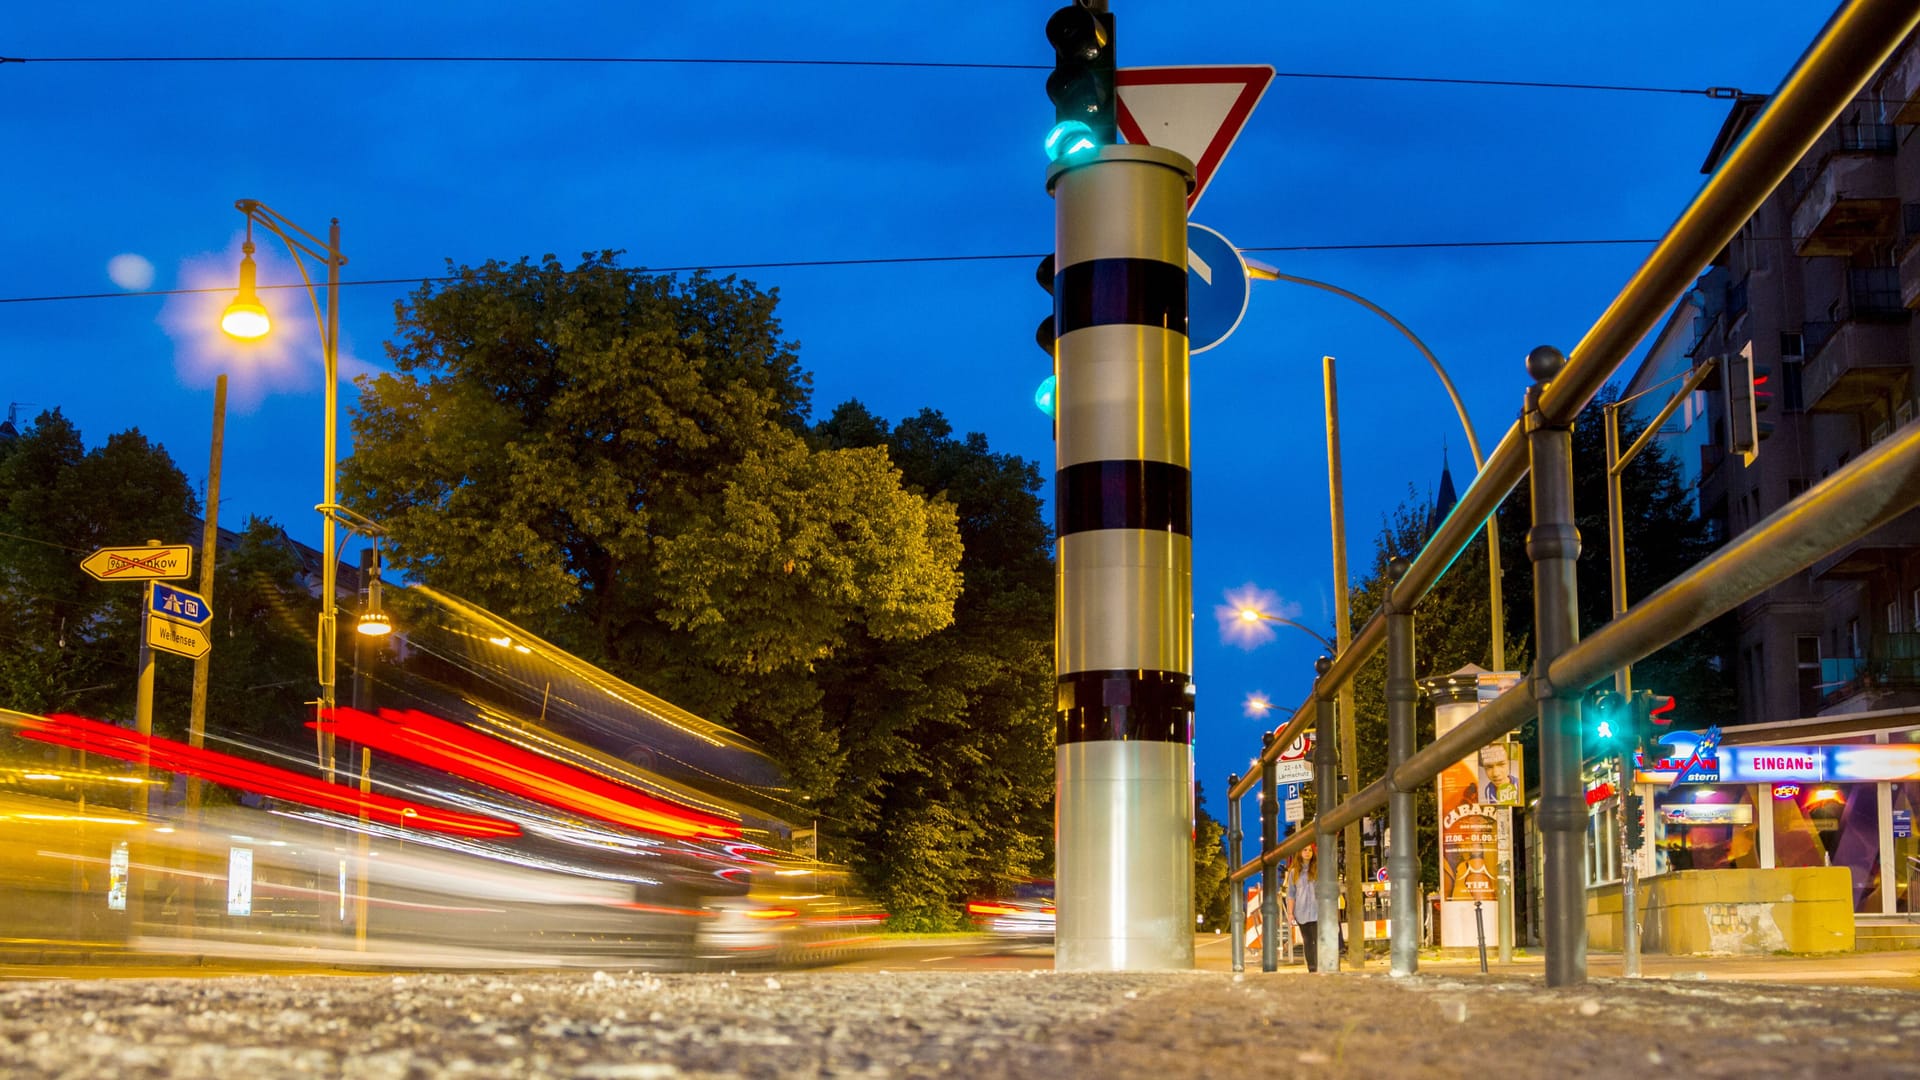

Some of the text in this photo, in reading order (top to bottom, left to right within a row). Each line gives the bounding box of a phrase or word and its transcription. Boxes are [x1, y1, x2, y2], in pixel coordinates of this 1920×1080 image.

[132, 557, 177, 569] Pnkow
[1634, 752, 1717, 772] VLKAN
[1753, 757, 1813, 770] EINGANG
[1688, 773, 1718, 781] stern
[1773, 786, 1799, 797] OPEN
[1465, 881, 1489, 889] TIPI
